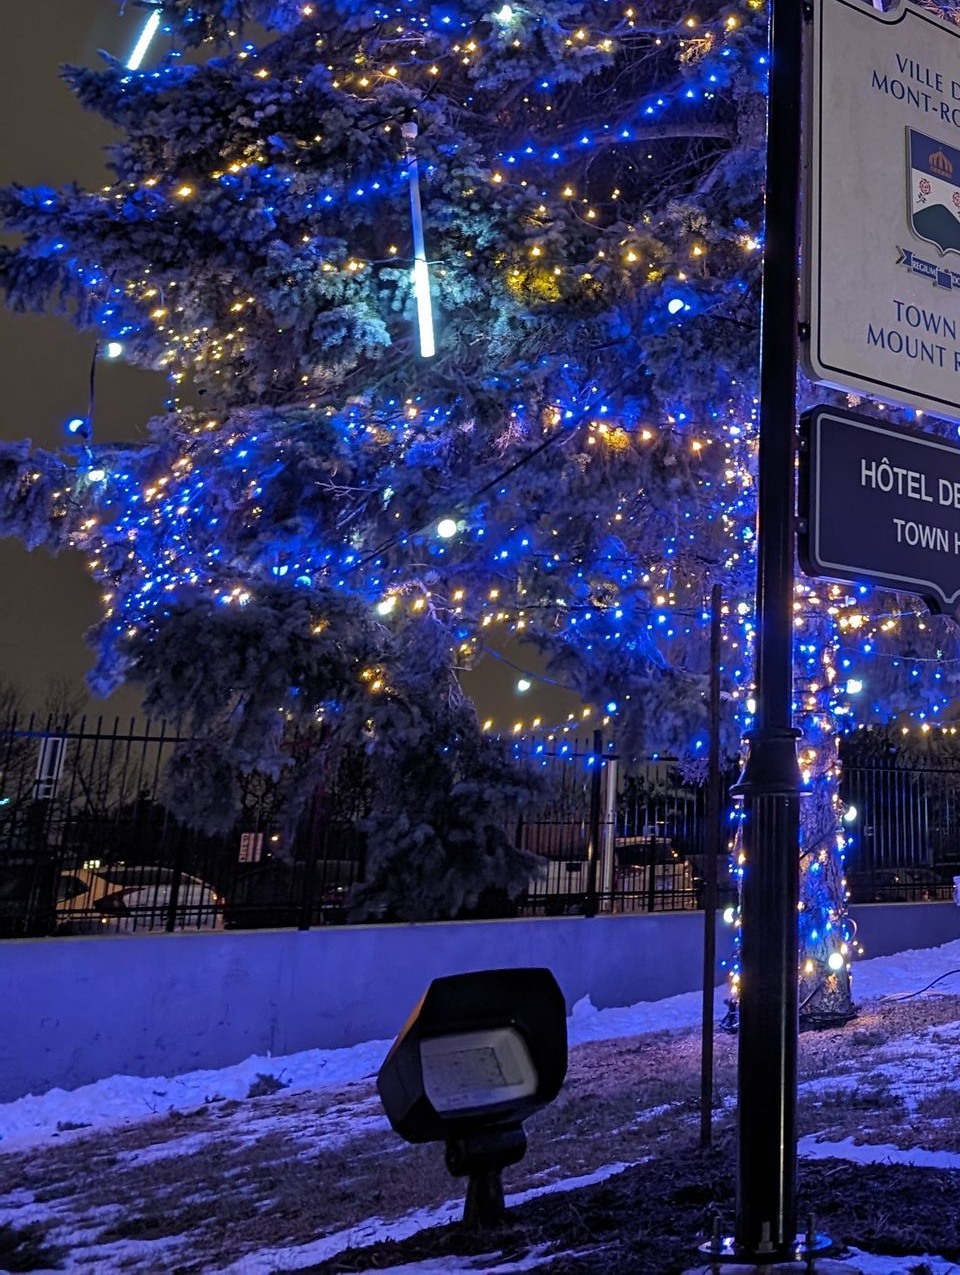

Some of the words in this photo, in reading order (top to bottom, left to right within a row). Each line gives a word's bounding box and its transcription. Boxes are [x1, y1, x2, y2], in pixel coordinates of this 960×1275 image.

[896, 53, 943, 93] VILLE
[893, 299, 956, 340] TOWN
[867, 323, 946, 367] MOUNT
[860, 457, 933, 502] HÔTEL
[893, 518, 949, 553] TOWN
